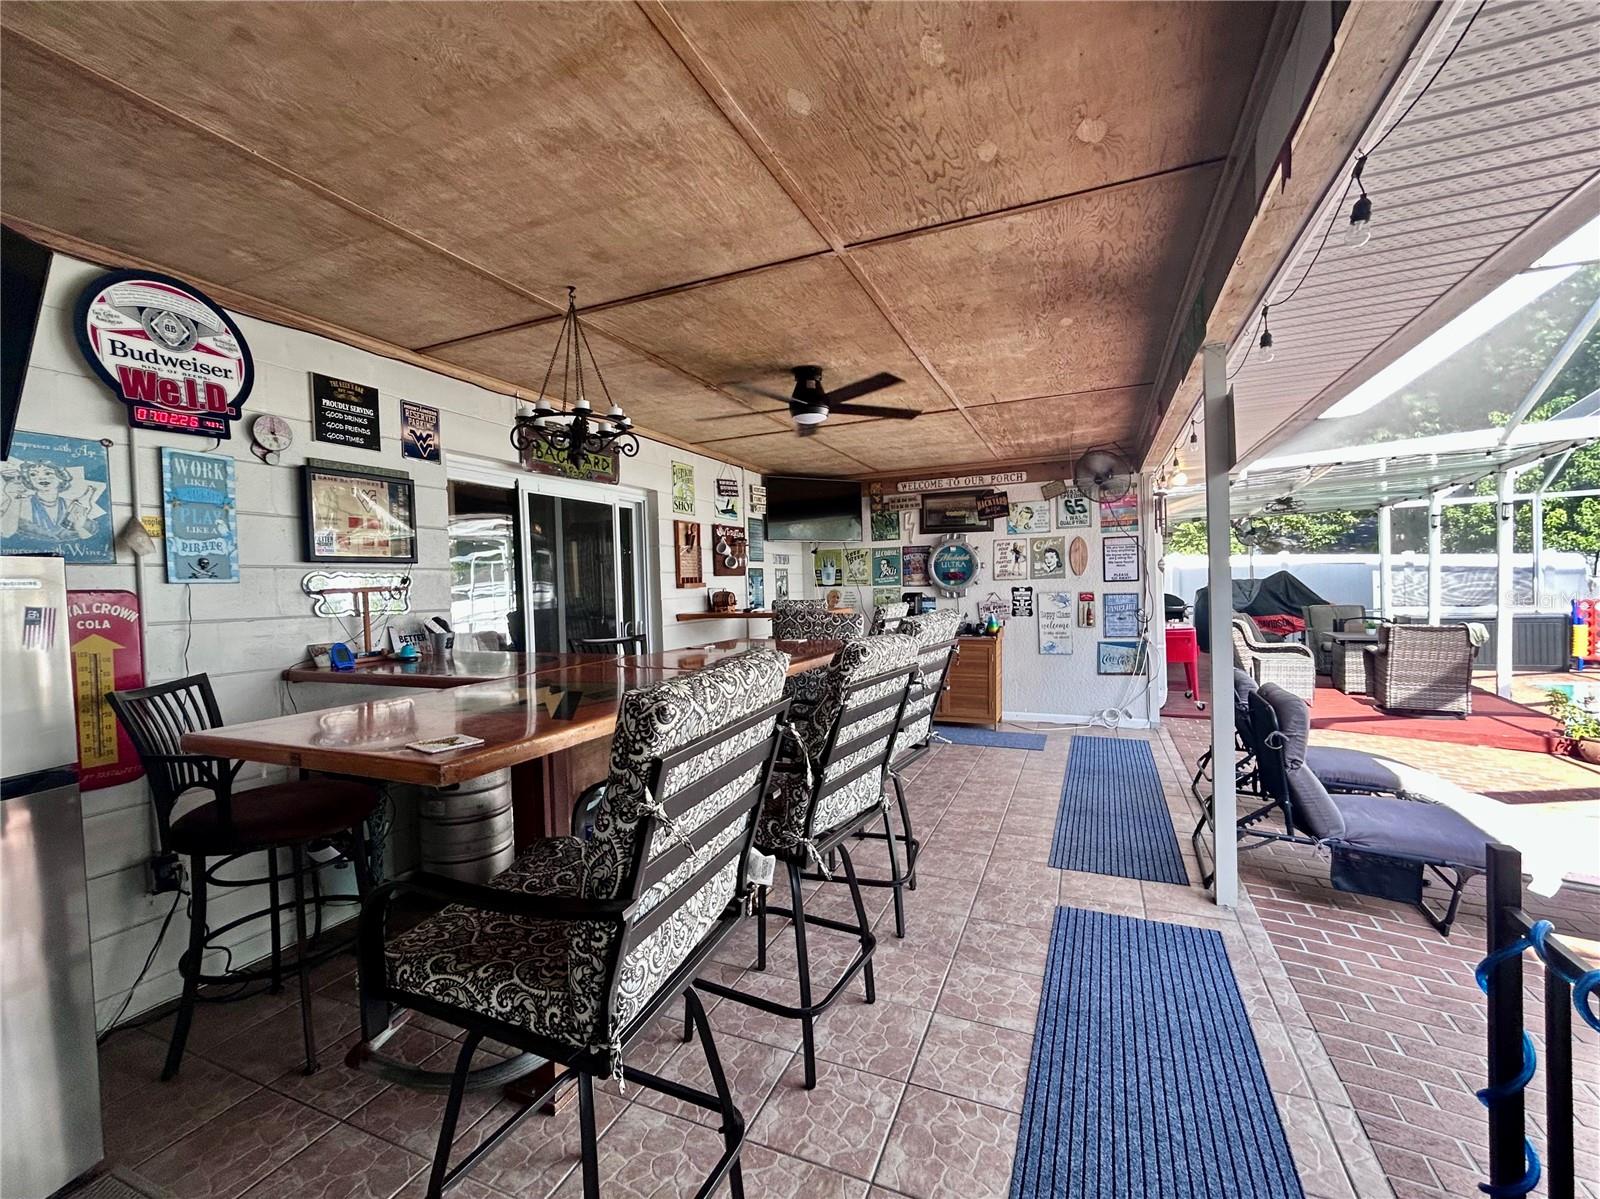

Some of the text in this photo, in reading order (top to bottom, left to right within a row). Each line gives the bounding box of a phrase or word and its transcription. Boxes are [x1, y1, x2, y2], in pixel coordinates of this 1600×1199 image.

[108, 338, 233, 379] Budweiser
[322, 399, 374, 416] PROUDLY SERVING
[325, 410, 368, 424] GOOD DRINKS
[405, 409, 436, 423] RESERVED
[326, 421, 371, 435] GOOD FRIENDS
[408, 418, 434, 430] PARKING
[326, 432, 364, 444] GOOD TIMES
[174, 458, 224, 480] WORK
[184, 478, 208, 487] LIKE
[900, 472, 1024, 491] WELCOME TO OUR PORCH
[674, 500, 693, 512] SHOT
[1065, 498, 1088, 515] 65
[180, 508, 222, 525] PLAY
[186, 526, 210, 534] LIKE
[182, 541, 224, 553] PIRATE
[92, 602, 139, 623] CROWN
[76, 619, 112, 630] COLA
[399, 633, 427, 643] BETTER
